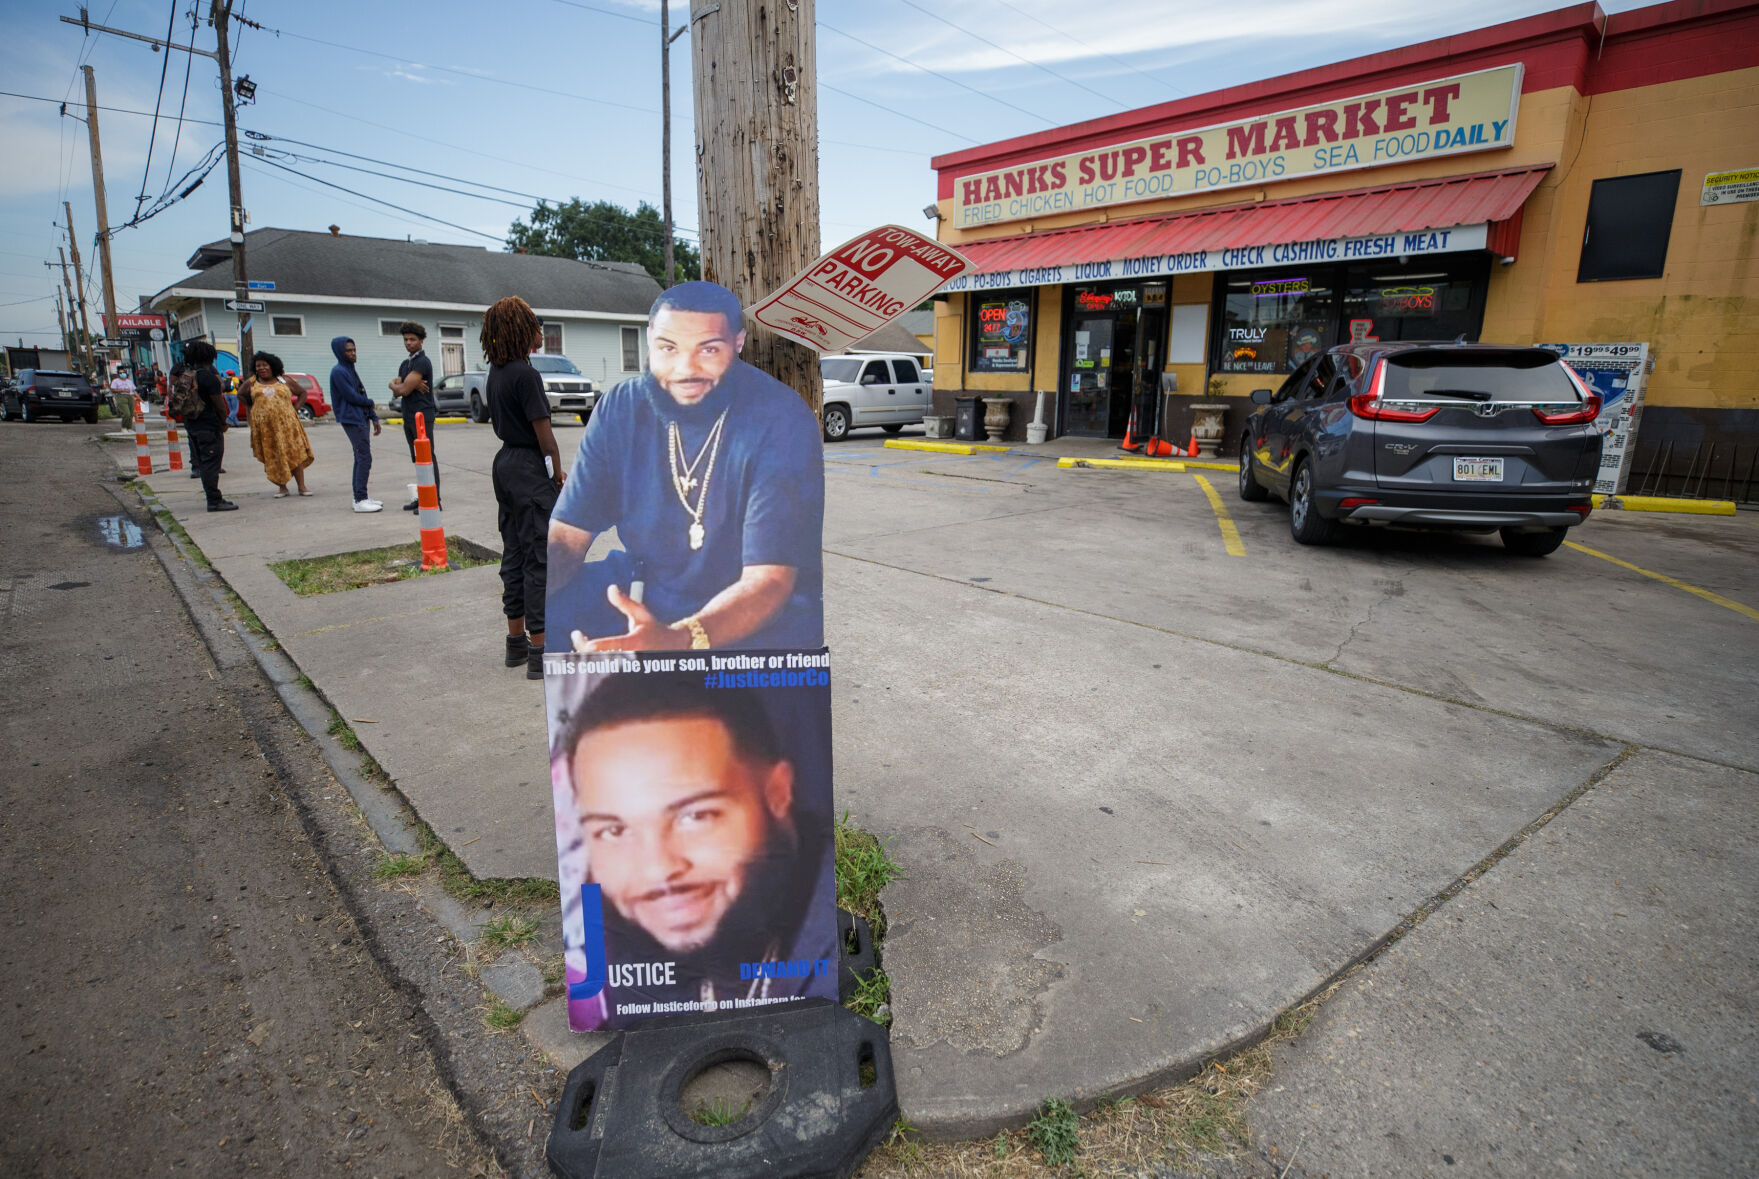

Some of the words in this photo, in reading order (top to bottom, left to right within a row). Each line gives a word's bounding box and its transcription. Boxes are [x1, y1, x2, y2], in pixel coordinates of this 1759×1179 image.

[1079, 136, 1205, 185] SUPER
[1226, 83, 1461, 160] MARKET
[964, 203, 1001, 224] FRIED
[1009, 190, 1074, 216] CHICKEN
[1084, 183, 1117, 205] HOT
[1124, 173, 1173, 198] FOOD
[1195, 155, 1285, 188] PO-BOYS
[1313, 143, 1359, 169] SEA
[1374, 131, 1430, 160] FOOD
[1434, 119, 1508, 149] DAILY
[1706, 175, 1738, 184] SECURITY
[840, 239, 894, 272] NO
[878, 228, 962, 272] TOW-AWAY
[944, 275, 967, 291] OOD
[1019, 265, 1062, 284] CIGARETS
[1075, 260, 1112, 280] LIQUOR
[1122, 256, 1163, 275] MONEY
[1168, 250, 1207, 270] ORDER
[1222, 246, 1265, 267] CHECK
[1273, 239, 1337, 263] CASHING
[1343, 236, 1395, 258] FRESH
[1403, 231, 1451, 253] MEAT
[813, 260, 905, 317] PARKING
[1114, 290, 1137, 302] KOOL
[1251, 281, 1309, 294] OYSTERS
[981, 308, 1006, 321] OPEN
[1229, 328, 1267, 339] TRULY
[1385, 443, 1418, 451] CR-V
[1457, 464, 1474, 475] 801
[1482, 464, 1500, 476] EML
[544, 659, 576, 675] This
[577, 658, 619, 674] could
[622, 658, 640, 672] be
[643, 659, 676, 673] your
[679, 657, 709, 673] son,
[711, 655, 766, 671] brother
[769, 655, 784, 669] or
[786, 653, 829, 668] friend
[704, 668, 829, 689] #JusticeforCo
[740, 960, 810, 980] DEMAND
[814, 959, 830, 977] IT
[616, 1003, 651, 1015] Follow
[719, 1000, 734, 1010] on
